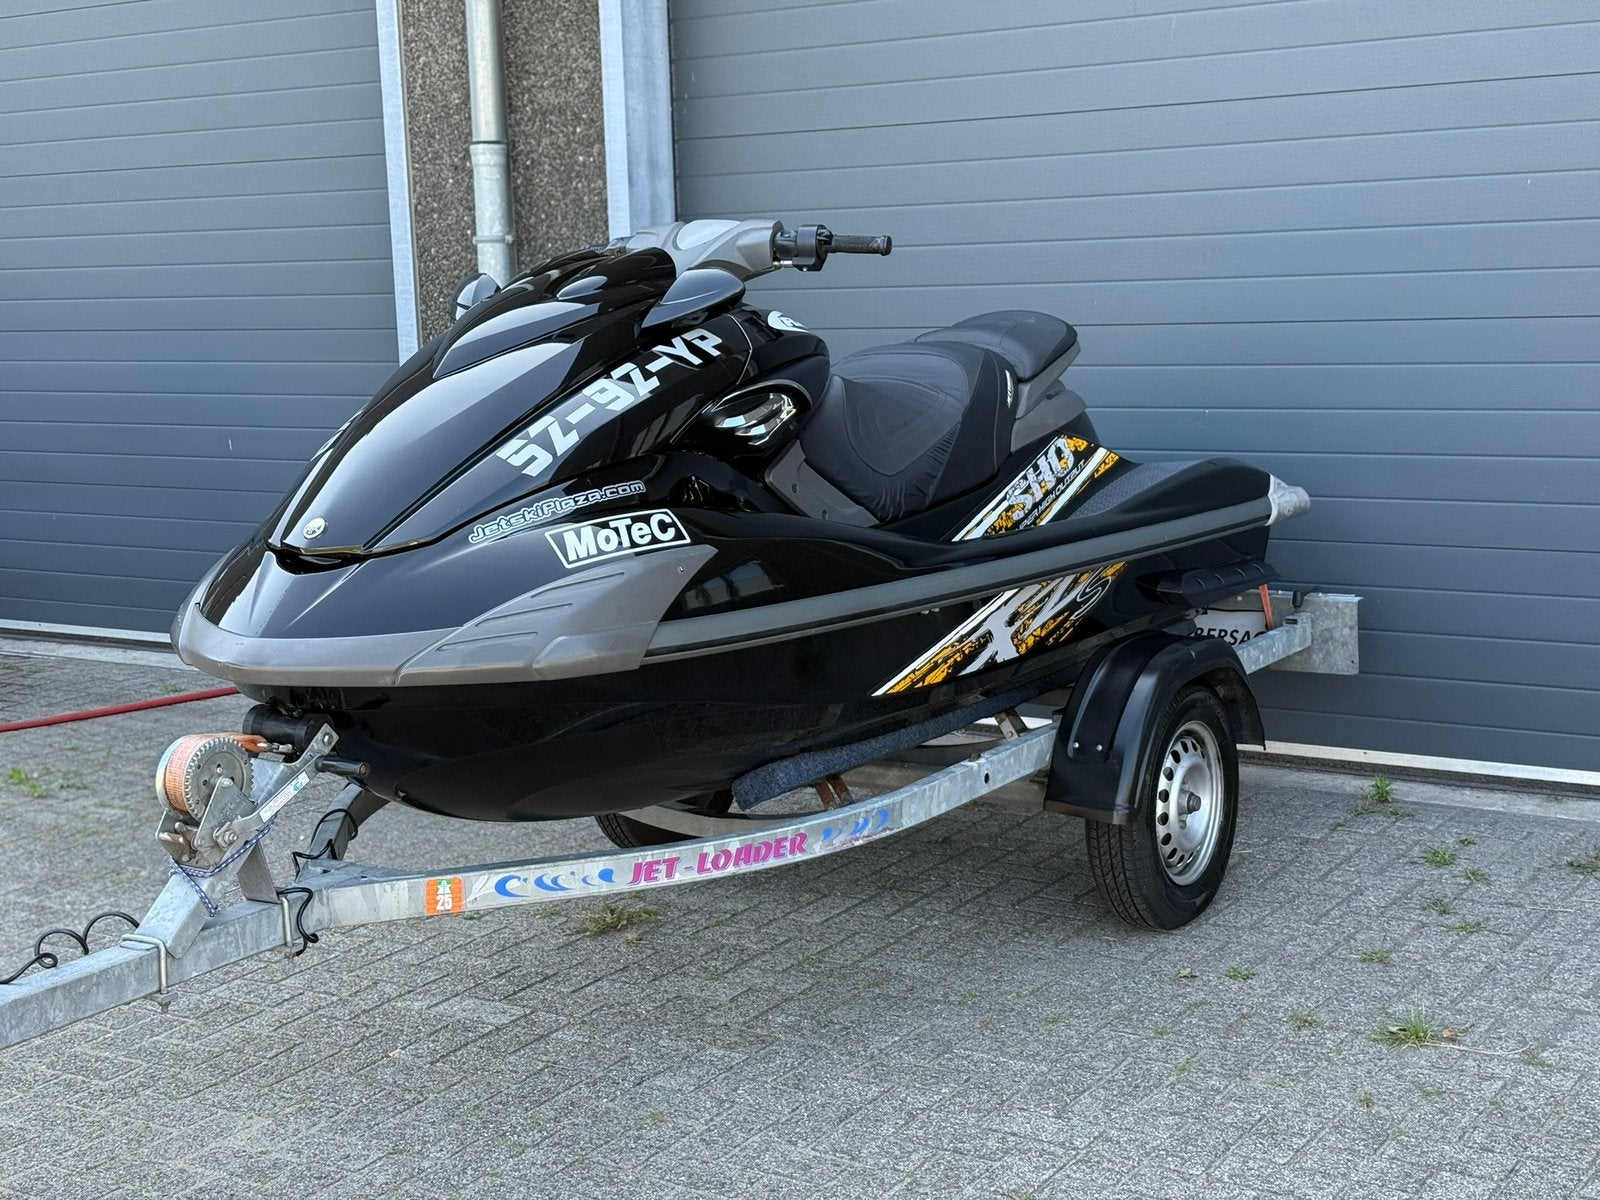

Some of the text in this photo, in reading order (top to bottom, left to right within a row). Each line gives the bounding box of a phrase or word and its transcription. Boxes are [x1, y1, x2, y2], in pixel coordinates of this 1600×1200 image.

[496, 328, 723, 477] 52-92-YP
[1007, 437, 1075, 521] SHO
[1038, 491, 1057, 512] HIGH
[1055, 459, 1086, 496] OUTPUT
[469, 481, 646, 543] JetskiPlaza.com
[563, 513, 676, 562] MoTeC
[436, 894, 453, 911] 25
